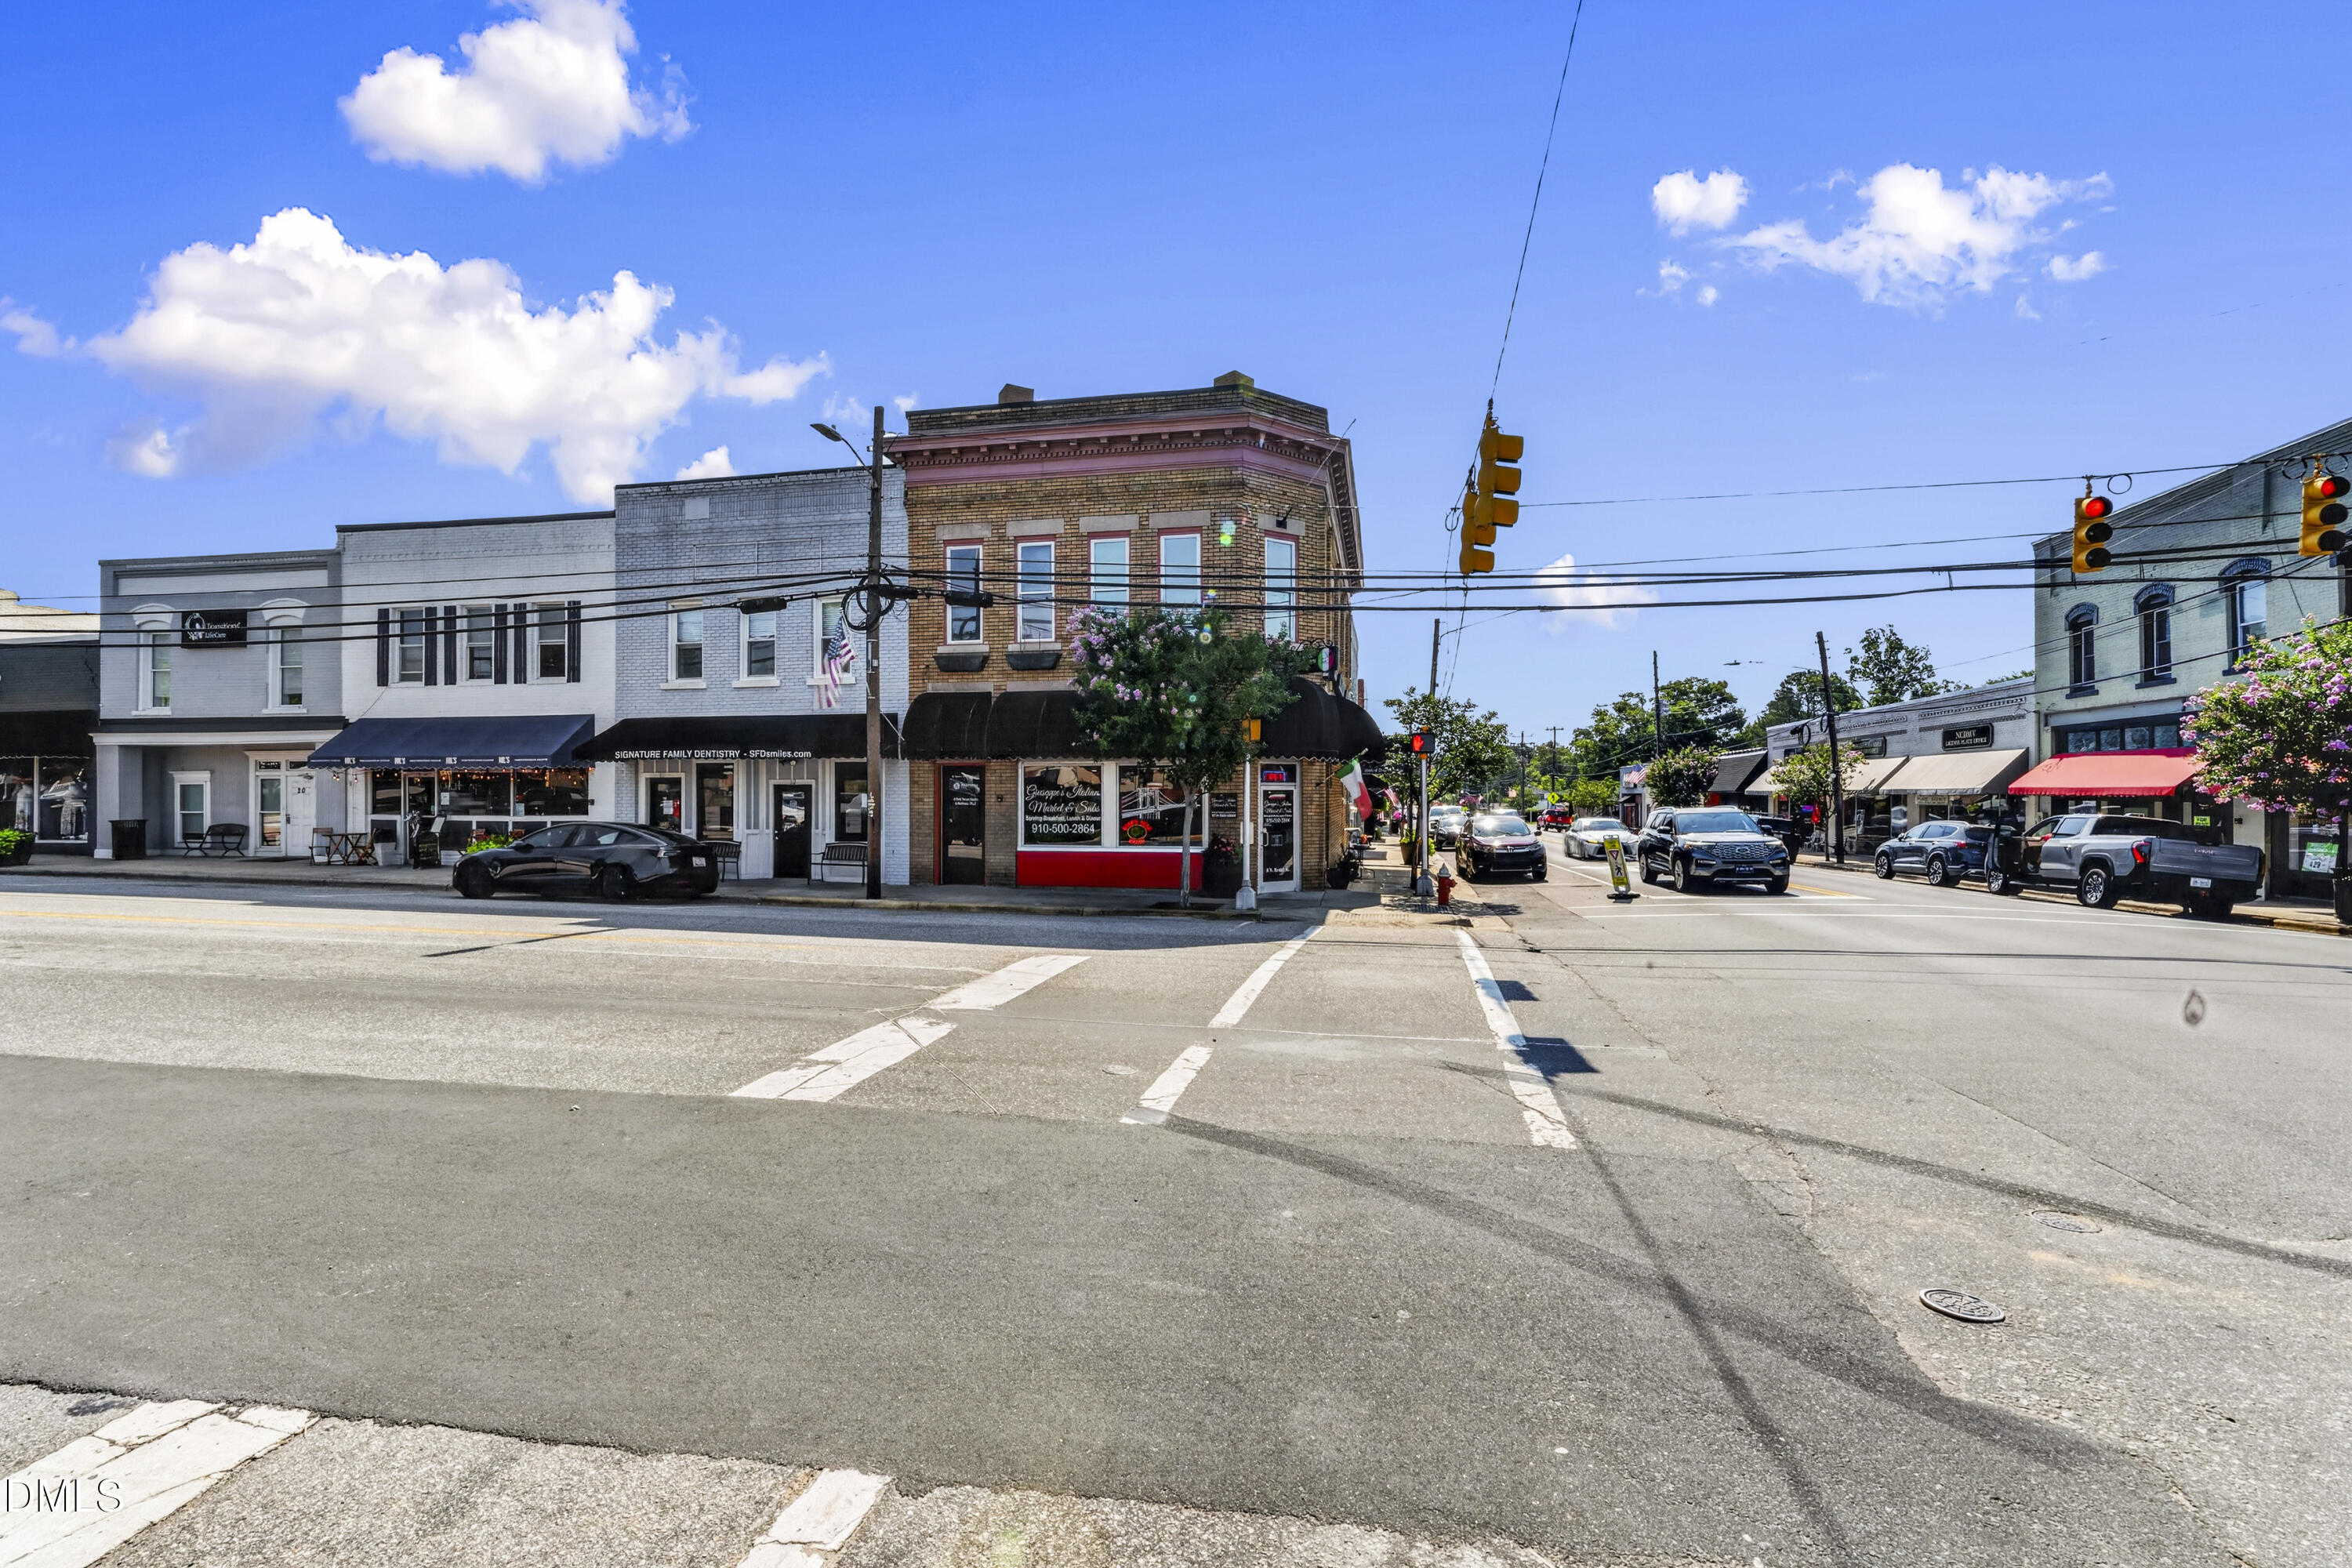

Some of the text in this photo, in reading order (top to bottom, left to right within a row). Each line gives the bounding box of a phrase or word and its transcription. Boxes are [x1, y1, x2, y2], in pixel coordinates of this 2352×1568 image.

[1955, 729, 1976, 739] NCDMV
[615, 750, 661, 759] SIGNATURE
[662, 750, 692, 758] FAMILY
[694, 750, 741, 758] DENTISTRY
[749, 750, 811, 758] SFDsmiles.com
[1029, 800, 1065, 813] Market
[1032, 823, 1095, 833] 910-500-2864
